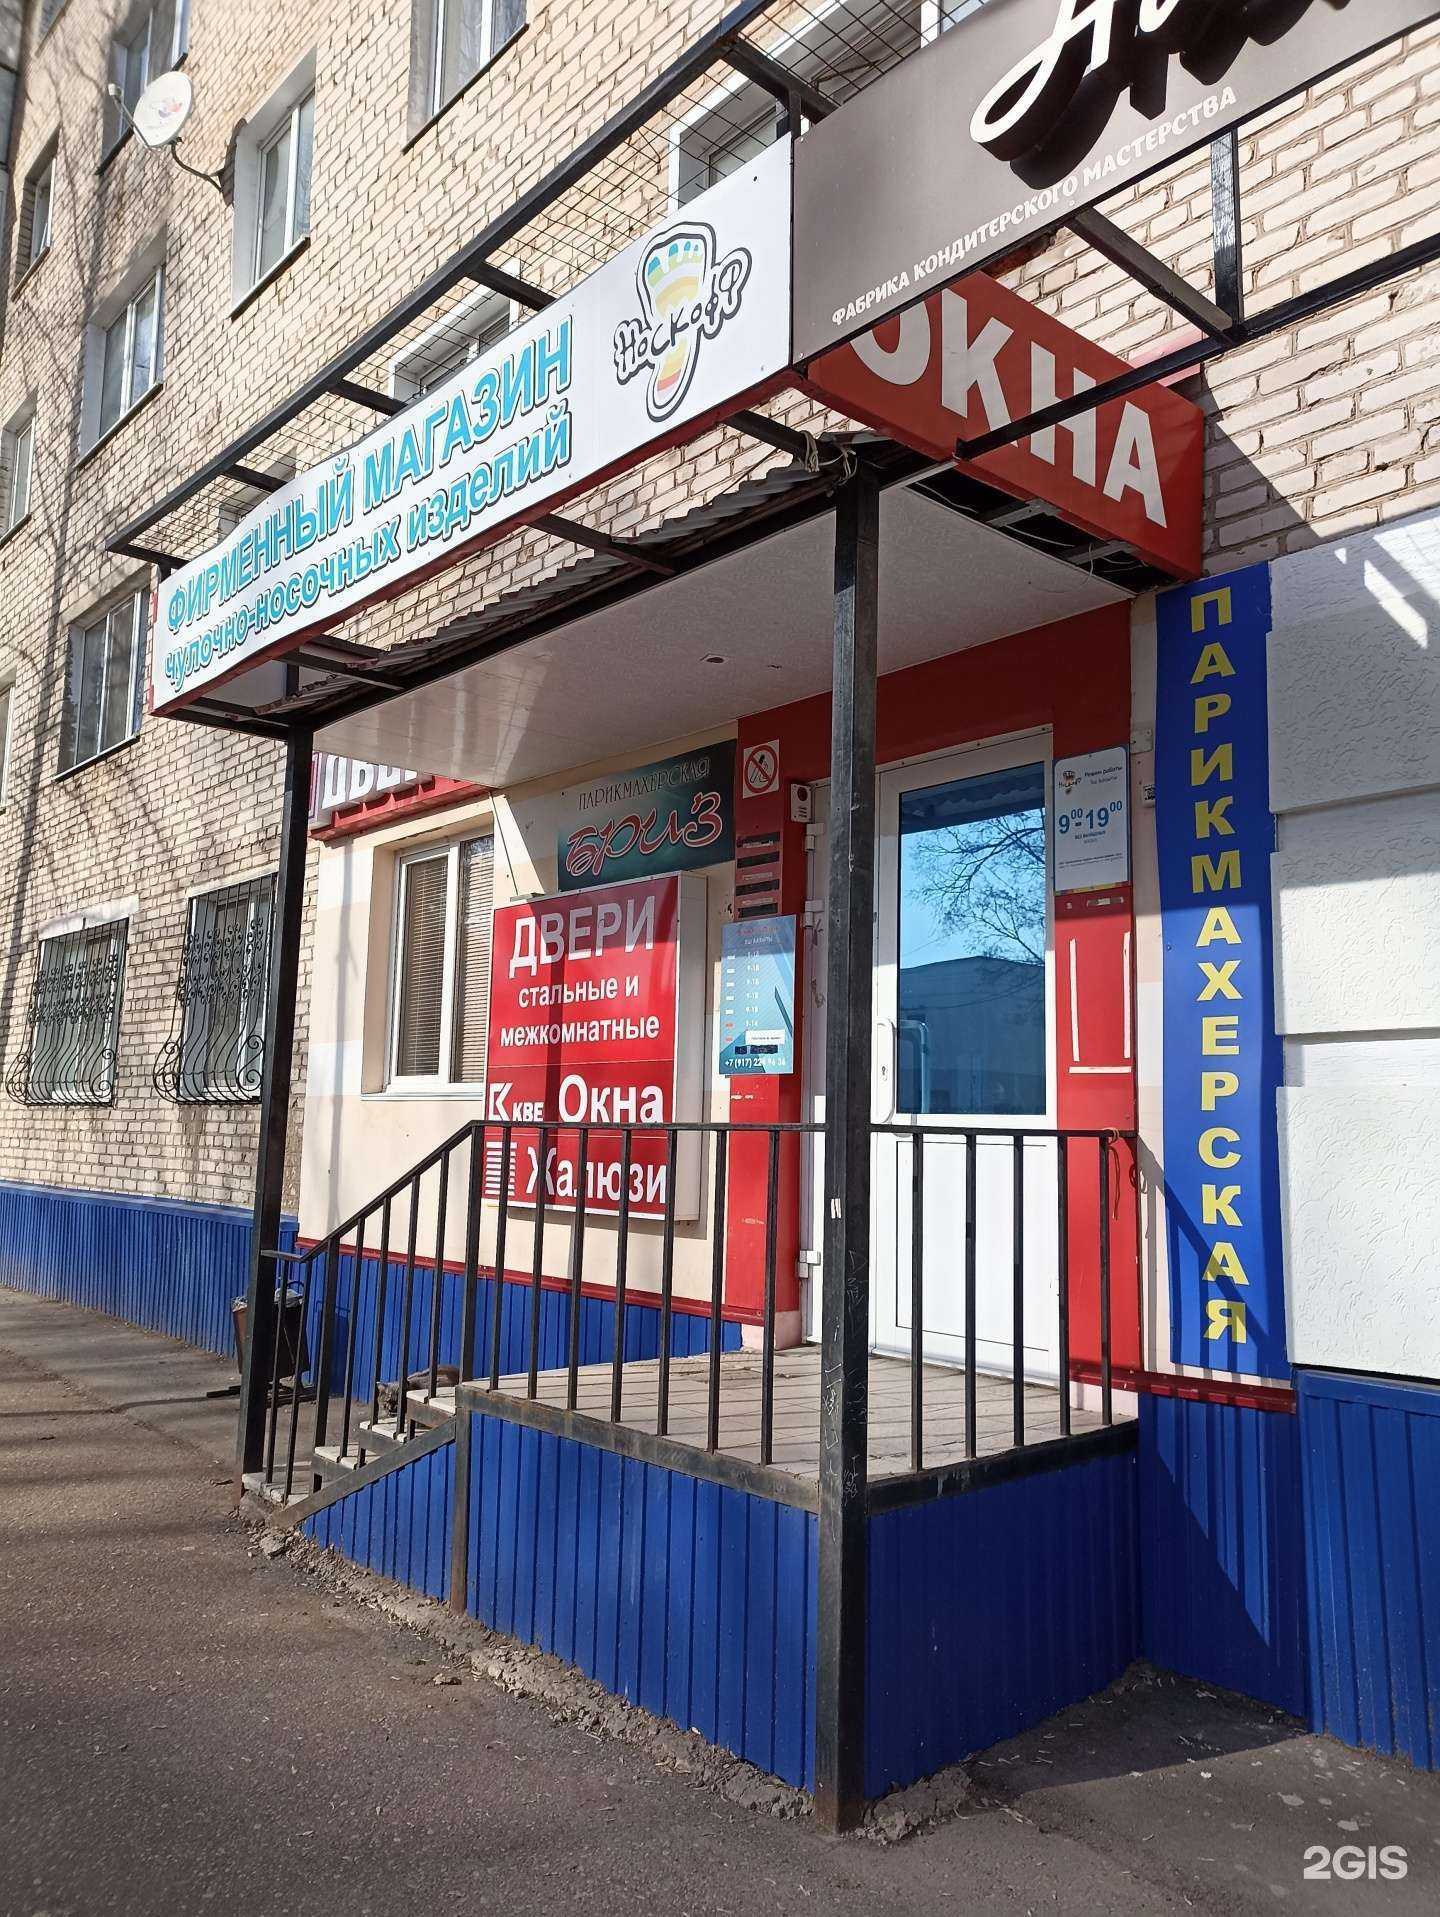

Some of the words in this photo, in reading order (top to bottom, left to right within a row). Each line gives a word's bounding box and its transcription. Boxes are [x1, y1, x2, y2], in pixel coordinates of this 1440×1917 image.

[832, 271, 910, 327] ФАБРИКА
[913, 177, 1078, 281] КОНДИТЕРСКОГО
[1083, 86, 1238, 187] МАСТЕРСТВА
[848, 286, 1168, 529] ОКНА
[167, 456, 354, 635] ФИРМЕННЫЙ
[362, 314, 573, 514] МАГАЗИН
[578, 756, 712, 811] ПАРИКМАХЕРСКАЯ
[509, 896, 656, 979] ДВЕРИ
[1190, 586, 1248, 1344] ПАРИКМАХЕРСКАЯ
[519, 977, 618, 1008] стальные
[625, 975, 639, 997] и
[500, 1015, 660, 1047] межкомнатные
[735, 1058, 752, 1069] (917)
[559, 1074, 664, 1124] Окна
